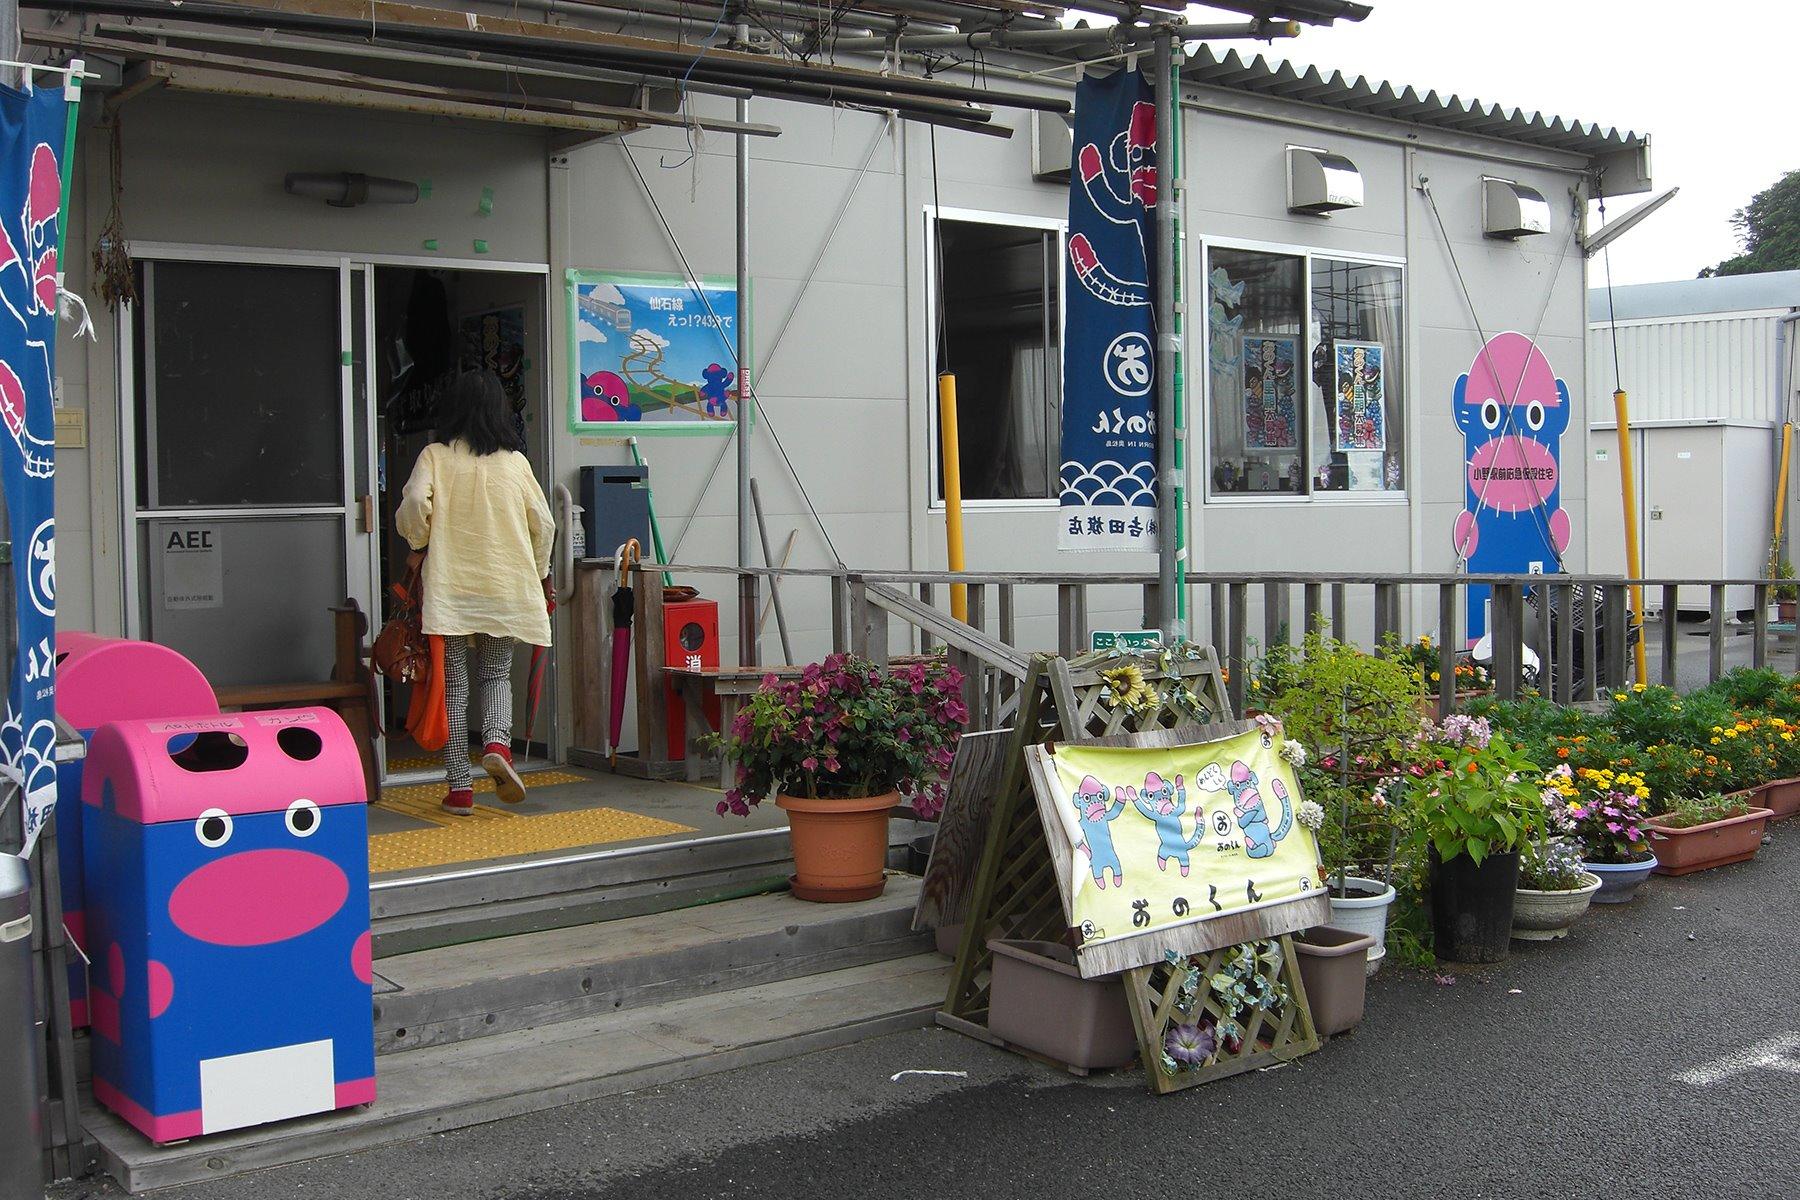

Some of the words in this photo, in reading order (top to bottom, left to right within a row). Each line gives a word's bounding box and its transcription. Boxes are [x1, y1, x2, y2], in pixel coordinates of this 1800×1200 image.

[649, 296, 684, 311] 仙石線
[1473, 467, 1554, 480] 小野駅前応急仮設住宅
[1216, 840, 1242, 852] おのくん
[1131, 878, 1263, 928] おのくん
